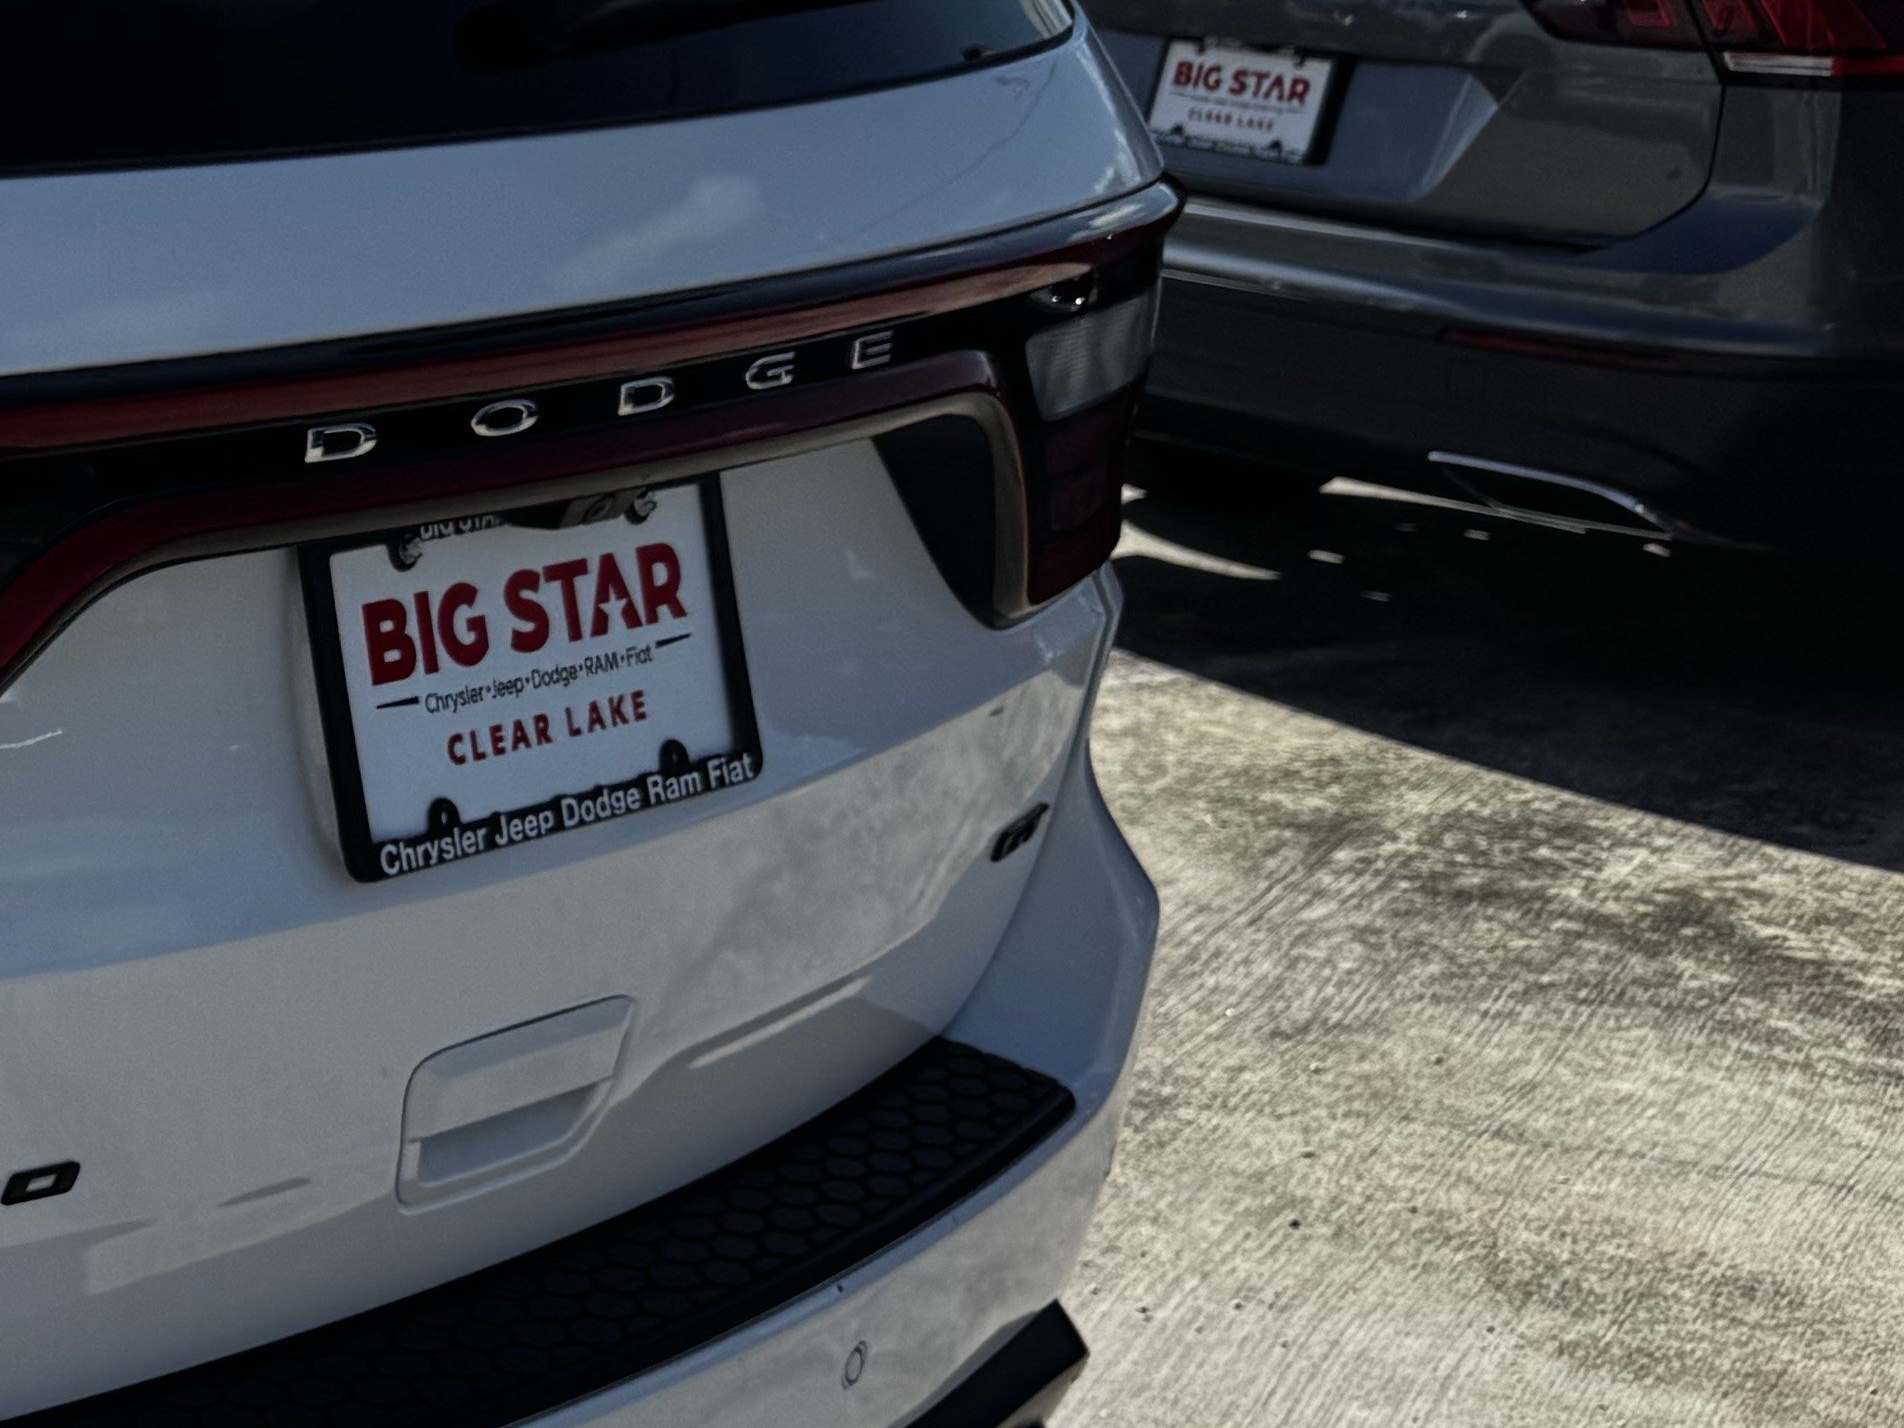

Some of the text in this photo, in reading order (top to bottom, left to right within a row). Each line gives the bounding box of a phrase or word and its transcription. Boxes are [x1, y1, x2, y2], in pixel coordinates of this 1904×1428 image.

[1173, 60, 1223, 92] BIG
[1229, 69, 1311, 105] STAR
[303, 329, 894, 464] DODGE
[361, 542, 688, 687] BIG STAR
[446, 689, 648, 766] CLEAR LAKE
[379, 752, 754, 875] Chrysler Jeep Dodge Ram Fiat
